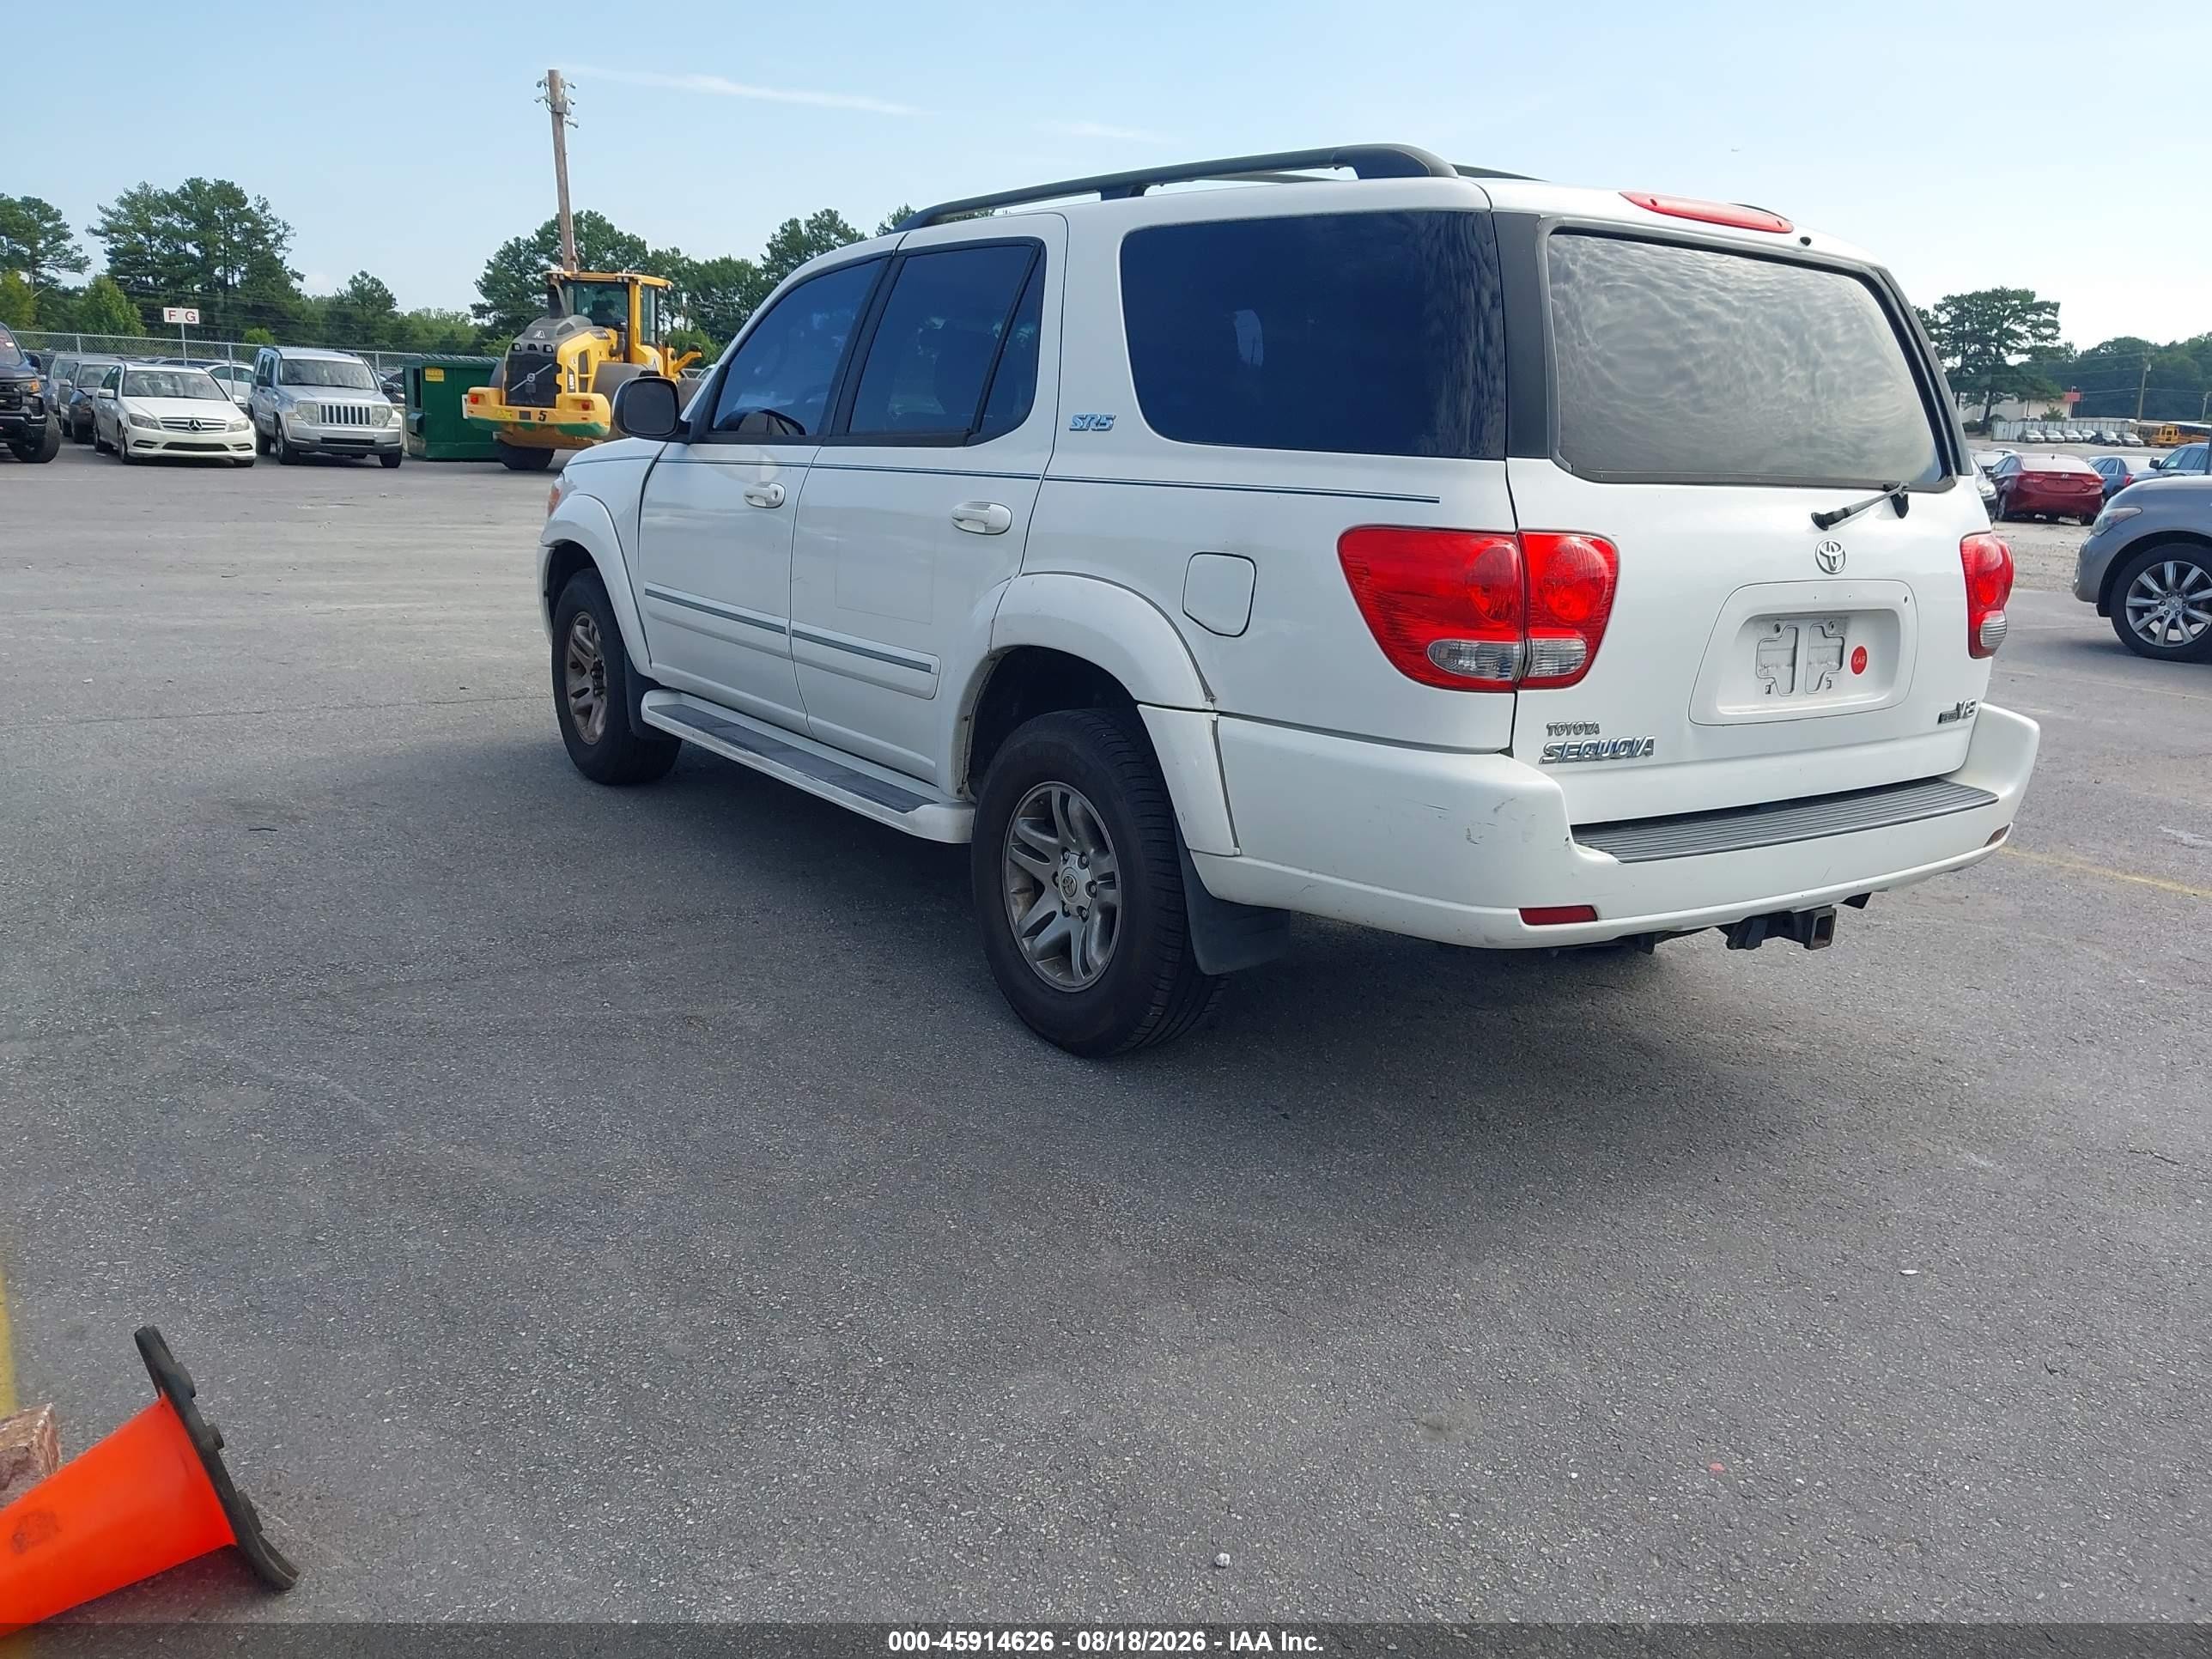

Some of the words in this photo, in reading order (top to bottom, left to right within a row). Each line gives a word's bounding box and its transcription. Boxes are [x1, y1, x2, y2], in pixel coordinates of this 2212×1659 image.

[168, 310, 176, 320] F
[185, 311, 196, 322] G
[538, 411, 547, 422] 5
[1069, 414, 1116, 432] SR5
[1955, 698, 1977, 719] V8
[1547, 721, 1601, 737] TOYOTA
[1539, 736, 1655, 763] SEQUOIA
